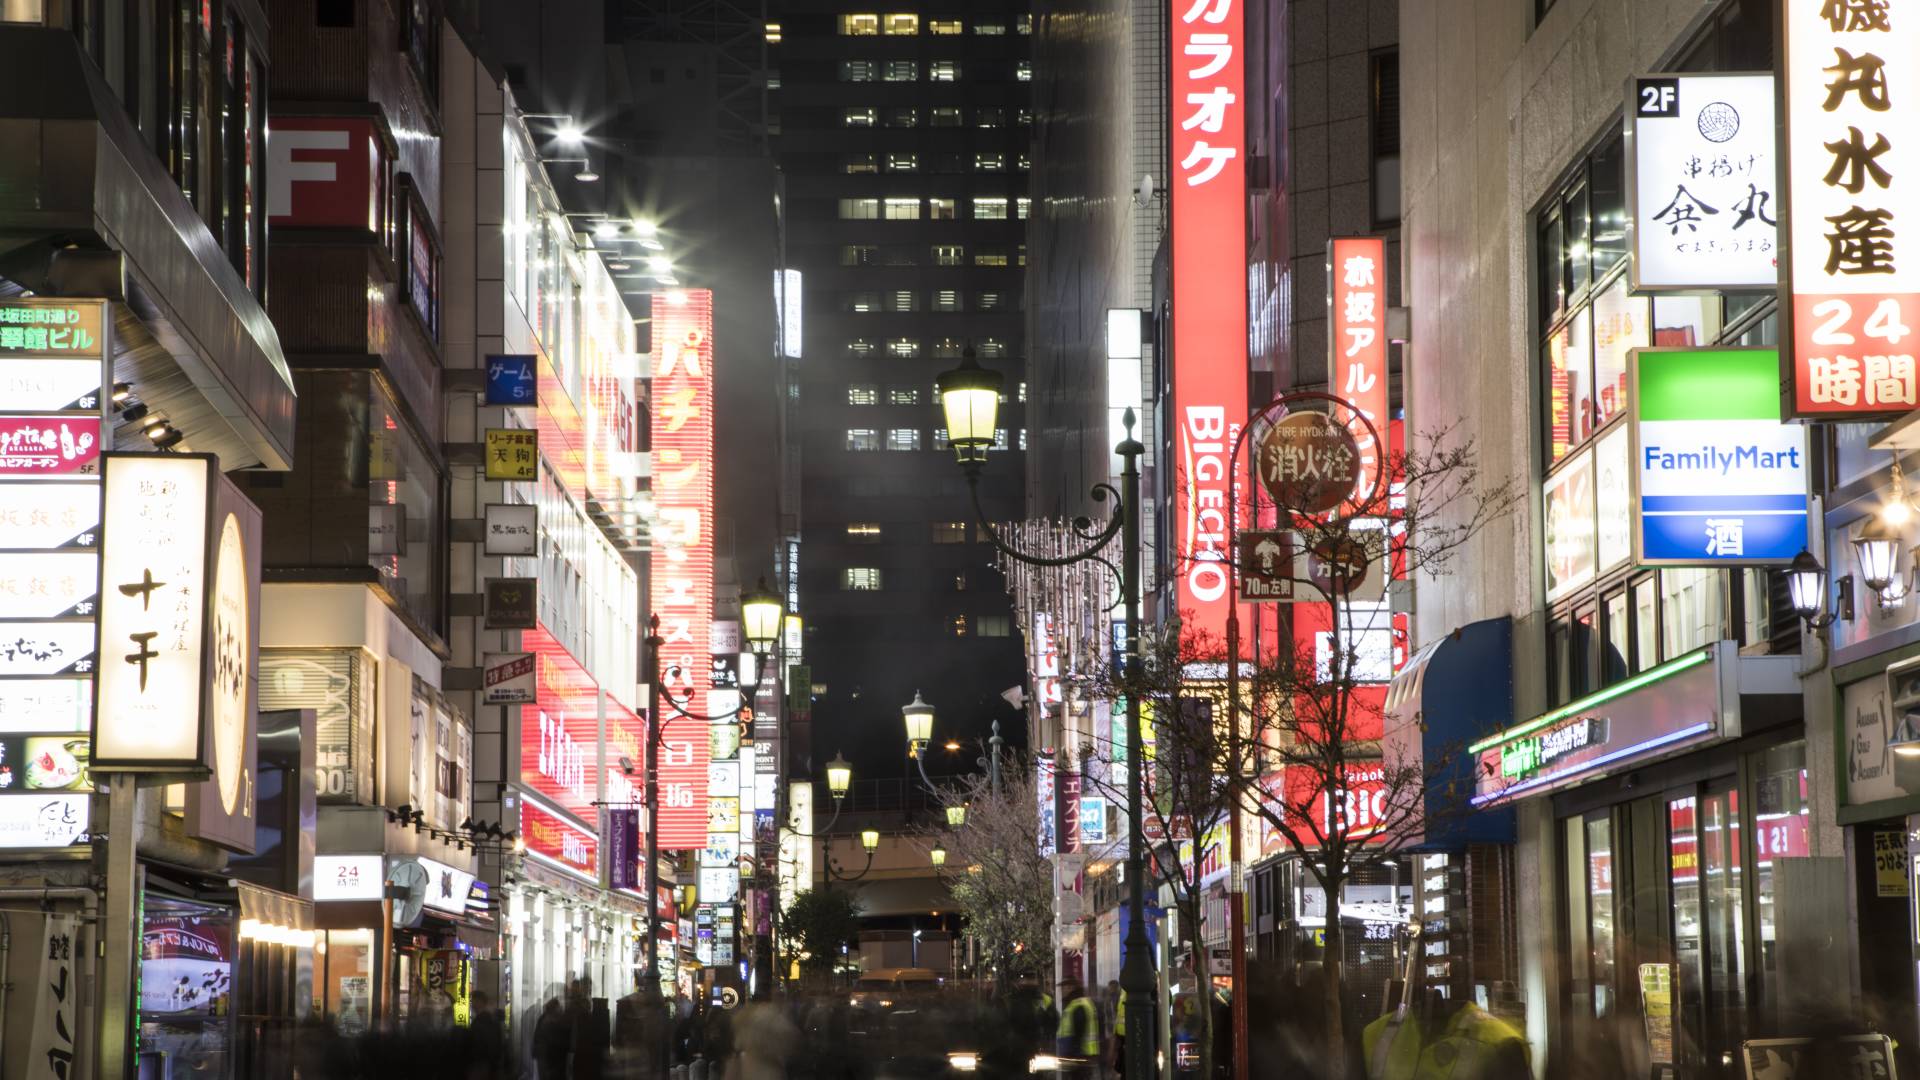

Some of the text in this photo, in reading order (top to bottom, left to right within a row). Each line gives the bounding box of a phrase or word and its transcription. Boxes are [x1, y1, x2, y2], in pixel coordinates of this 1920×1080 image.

[1641, 86, 1675, 112] 2F
[1811, 298, 1911, 345] 24
[489, 363, 533, 380] ゲーム
[1807, 354, 1917, 406] 時間
[513, 386, 533, 398] 5F
[79, 397, 96, 409] 6F
[1276, 427, 1297, 437] FIRE
[495, 448, 530, 463] 天狗
[1645, 446, 1800, 476] FamilyMart
[80, 465, 95, 473] 5F
[1269, 444, 1353, 482] 消火栓
[517, 467, 534, 476] 4F
[77, 534, 94, 546] 4F
[1705, 518, 1744, 556] 酒
[76, 603, 93, 615] 3F
[75, 660, 92, 672] 2F
[338, 865, 359, 878] 24
